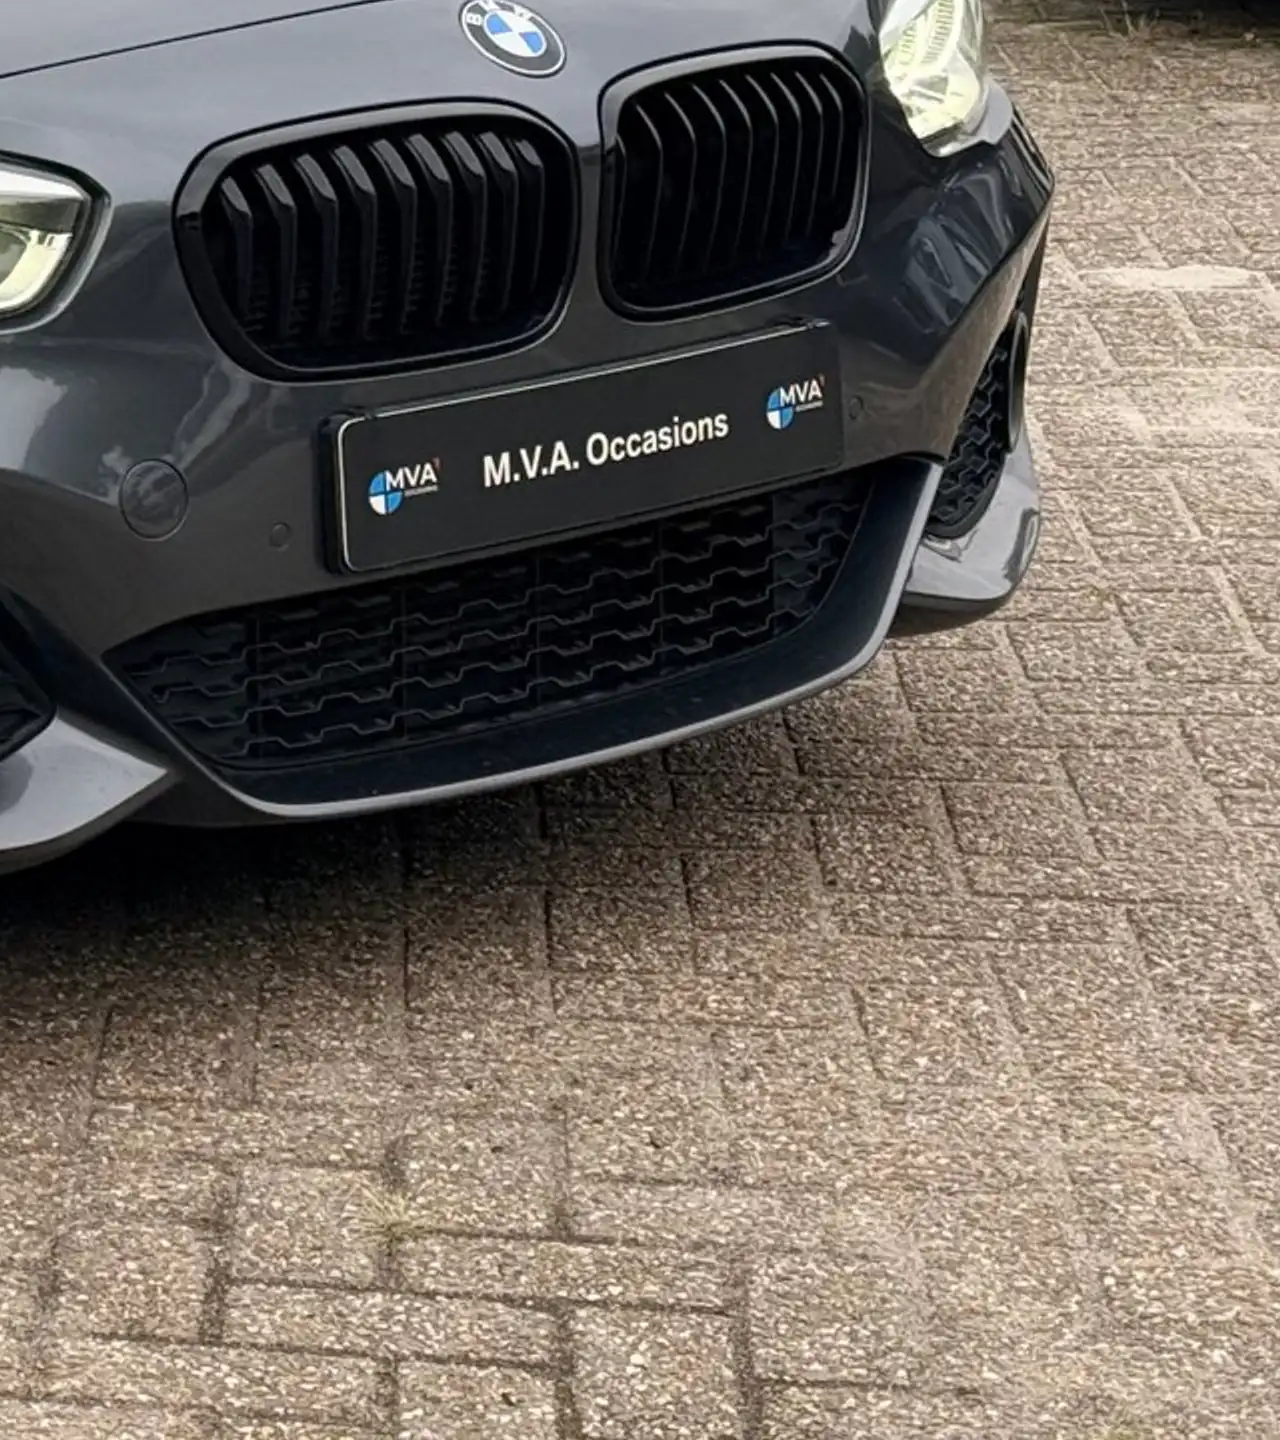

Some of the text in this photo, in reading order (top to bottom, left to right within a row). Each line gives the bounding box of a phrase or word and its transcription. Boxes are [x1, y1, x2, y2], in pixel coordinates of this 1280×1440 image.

[779, 378, 824, 408] MVA
[483, 412, 729, 488] M.V.A. Occasions
[384, 462, 438, 492] MVA
